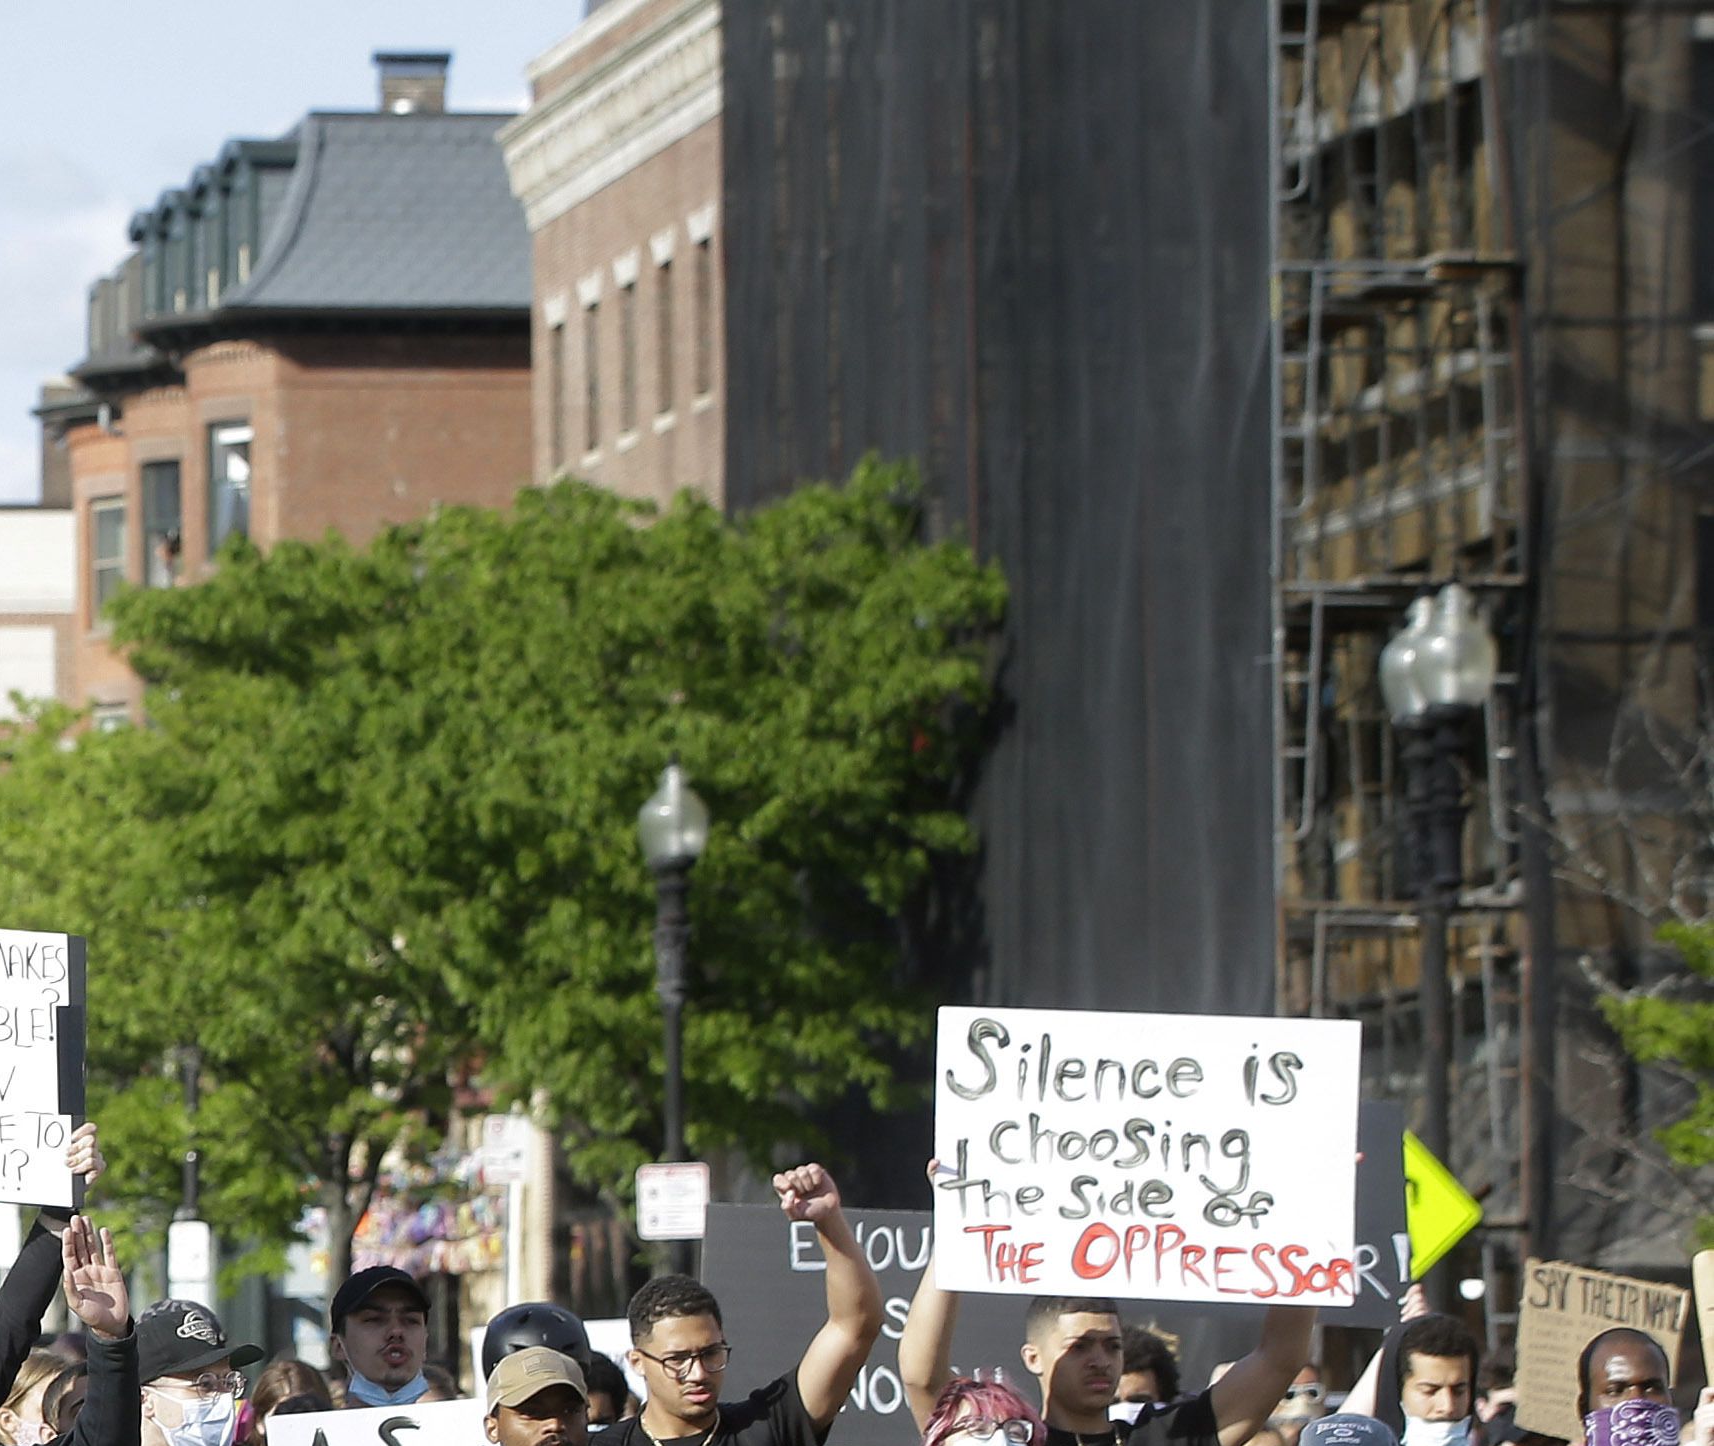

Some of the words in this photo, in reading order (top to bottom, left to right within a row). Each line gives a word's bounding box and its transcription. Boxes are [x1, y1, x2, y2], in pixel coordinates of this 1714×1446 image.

[946, 1017, 1205, 1102] Silence
[1241, 1043, 1304, 1106] is
[25, 1111, 66, 1149] TO
[938, 1138, 1046, 1218] the
[1202, 1190, 1276, 1230] of
[963, 1224, 1045, 1285] THE
[1072, 1222, 1358, 1300] OPPRESSOR
[1529, 1268, 1572, 1311] SAY
[1578, 1276, 1639, 1325] THEIR
